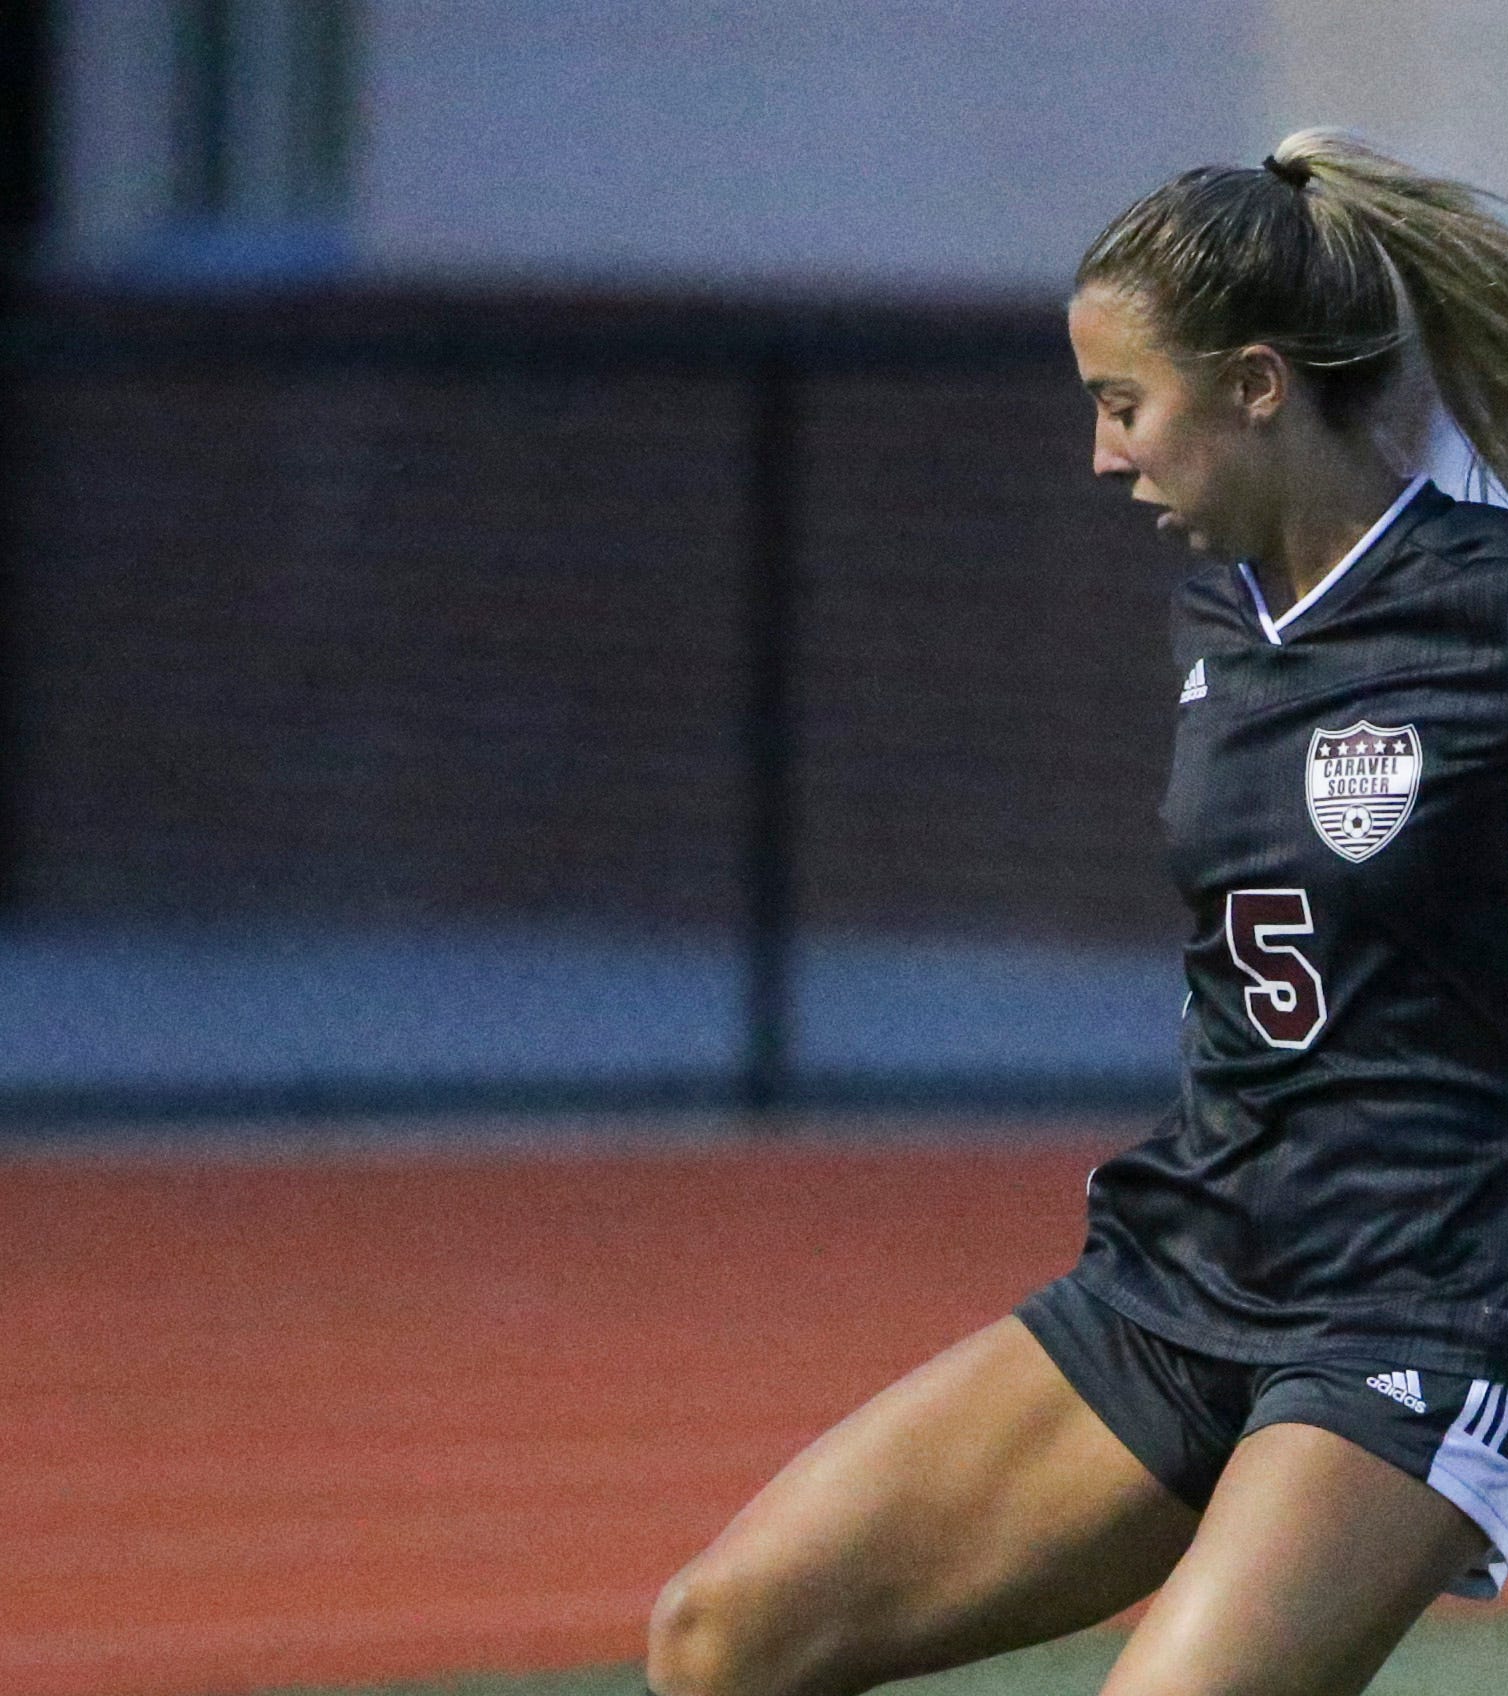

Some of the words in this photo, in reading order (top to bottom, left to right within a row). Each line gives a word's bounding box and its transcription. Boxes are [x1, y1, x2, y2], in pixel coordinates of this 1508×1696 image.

[1324, 757, 1399, 778] CARAVEL
[1328, 777, 1390, 796] SOCCER
[1226, 888, 1328, 1050] 5
[1366, 1376, 1427, 1414] adidas
